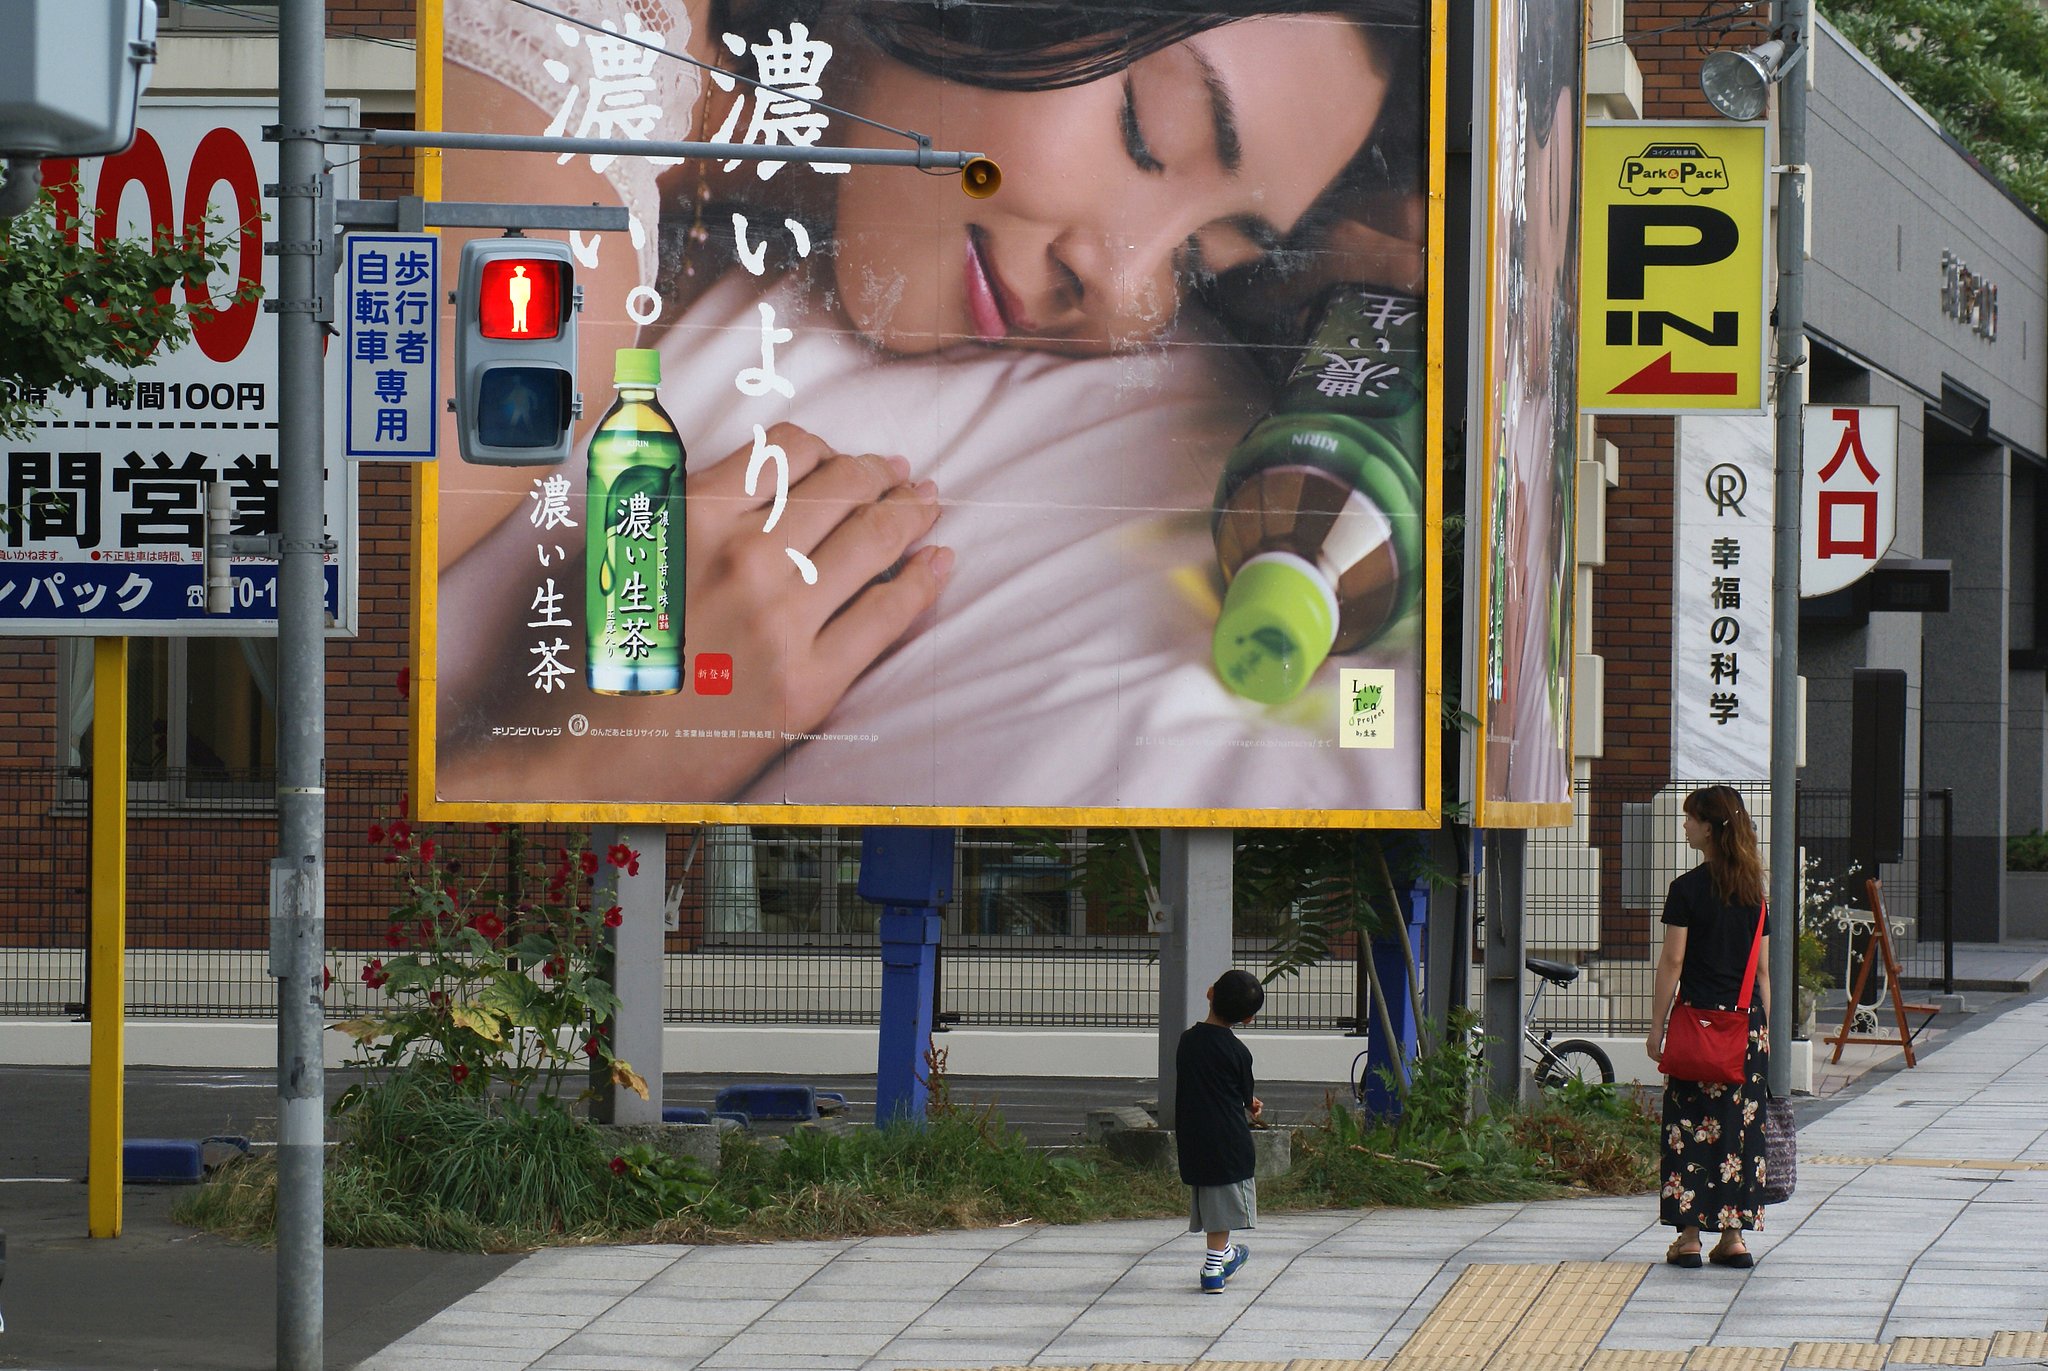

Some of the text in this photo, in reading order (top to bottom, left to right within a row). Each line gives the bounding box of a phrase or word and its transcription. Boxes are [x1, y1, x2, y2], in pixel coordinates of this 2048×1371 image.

[1607, 205, 1739, 300] P
[355, 250, 389, 364] 自転車
[395, 251, 429, 364] 歩行者
[710, 22, 851, 585] 濃いより、
[1606, 311, 1738, 346] IN
[374, 369, 408, 442] 専用
[1291, 432, 1339, 454] KIRIN
[1817, 408, 1881, 560] 入口
[527, 474, 579, 694] 濃い生茶
[616, 491, 657, 661] 濃い生茶
[658, 510, 670, 607] 濃くて甘い味
[697, 668, 730, 680] 新登場
[1709, 536, 1741, 726] 幸福の科学
[492, 727, 562, 736] キリンビバレッジ
[590, 728, 669, 737] のんだあとはリサイクル
[1352, 679, 1382, 694] Live
[1352, 697, 1377, 712] Tea
